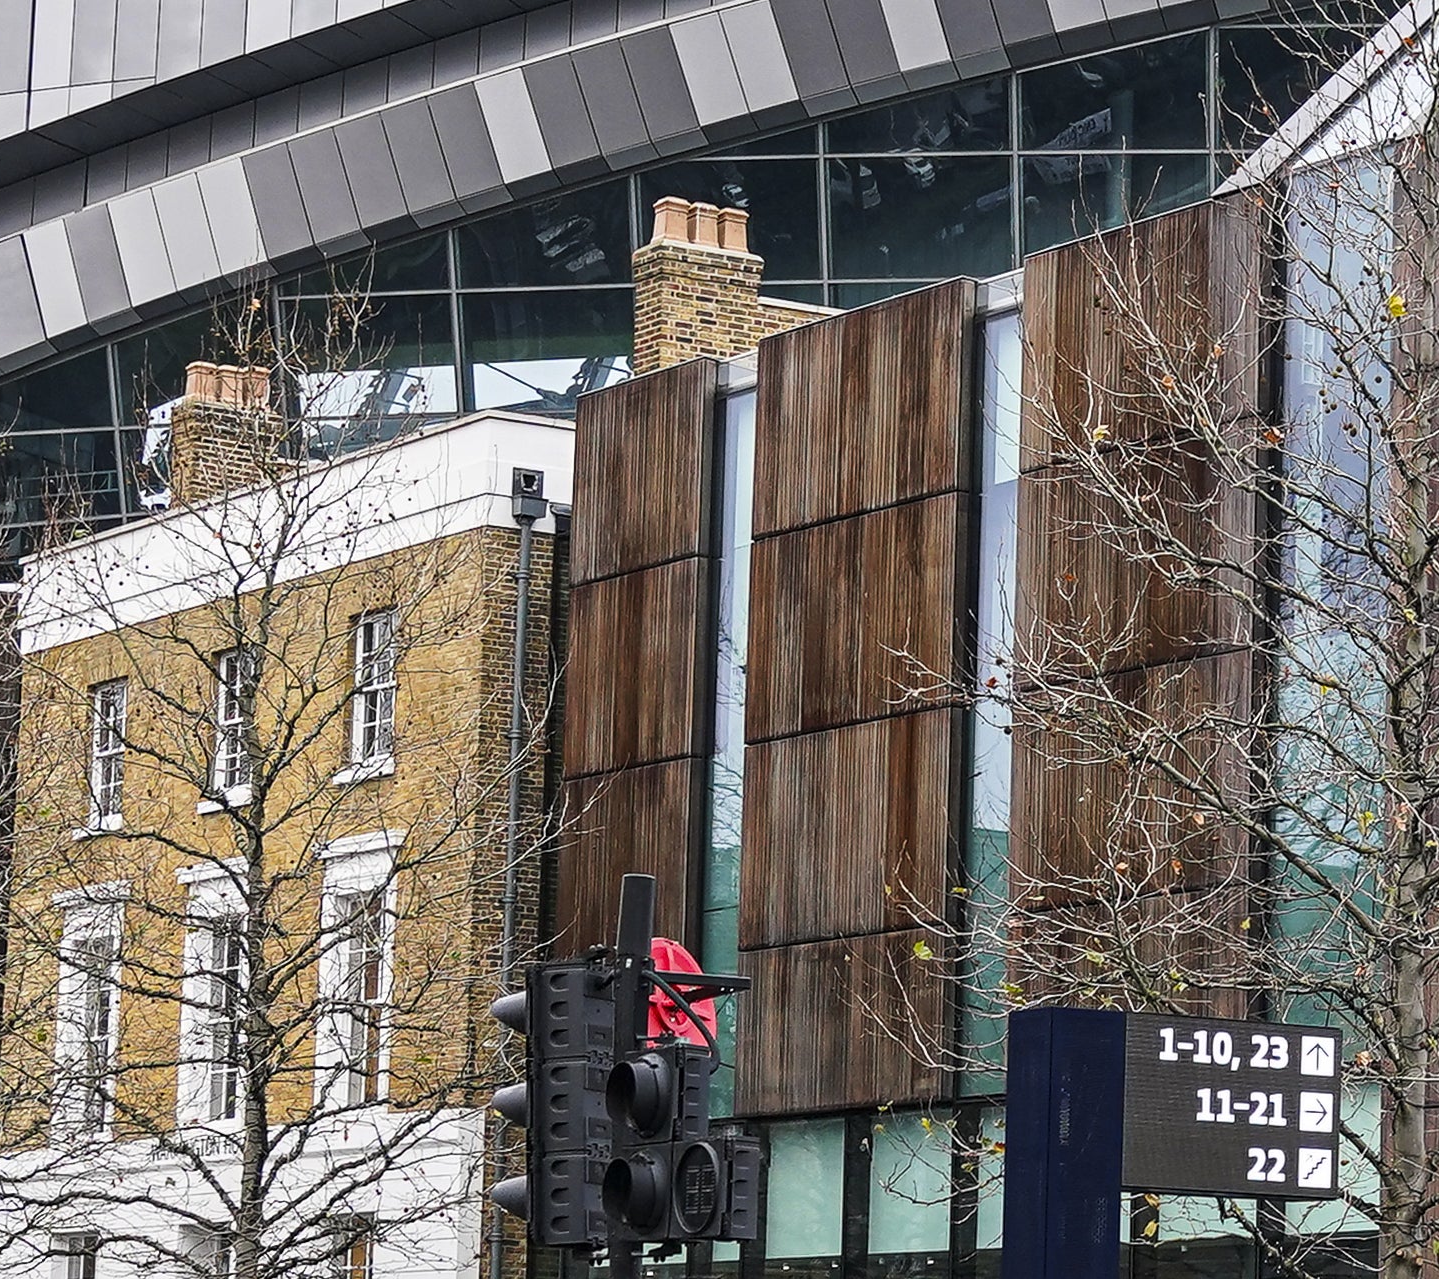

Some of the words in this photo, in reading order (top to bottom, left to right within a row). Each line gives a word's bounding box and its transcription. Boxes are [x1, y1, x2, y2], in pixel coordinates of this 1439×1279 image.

[1159, 1028, 1241, 1071] 1-10,
[1250, 1035, 1290, 1069] 23
[1196, 1088, 1288, 1127] 11-21
[1246, 1147, 1286, 1182] 22
